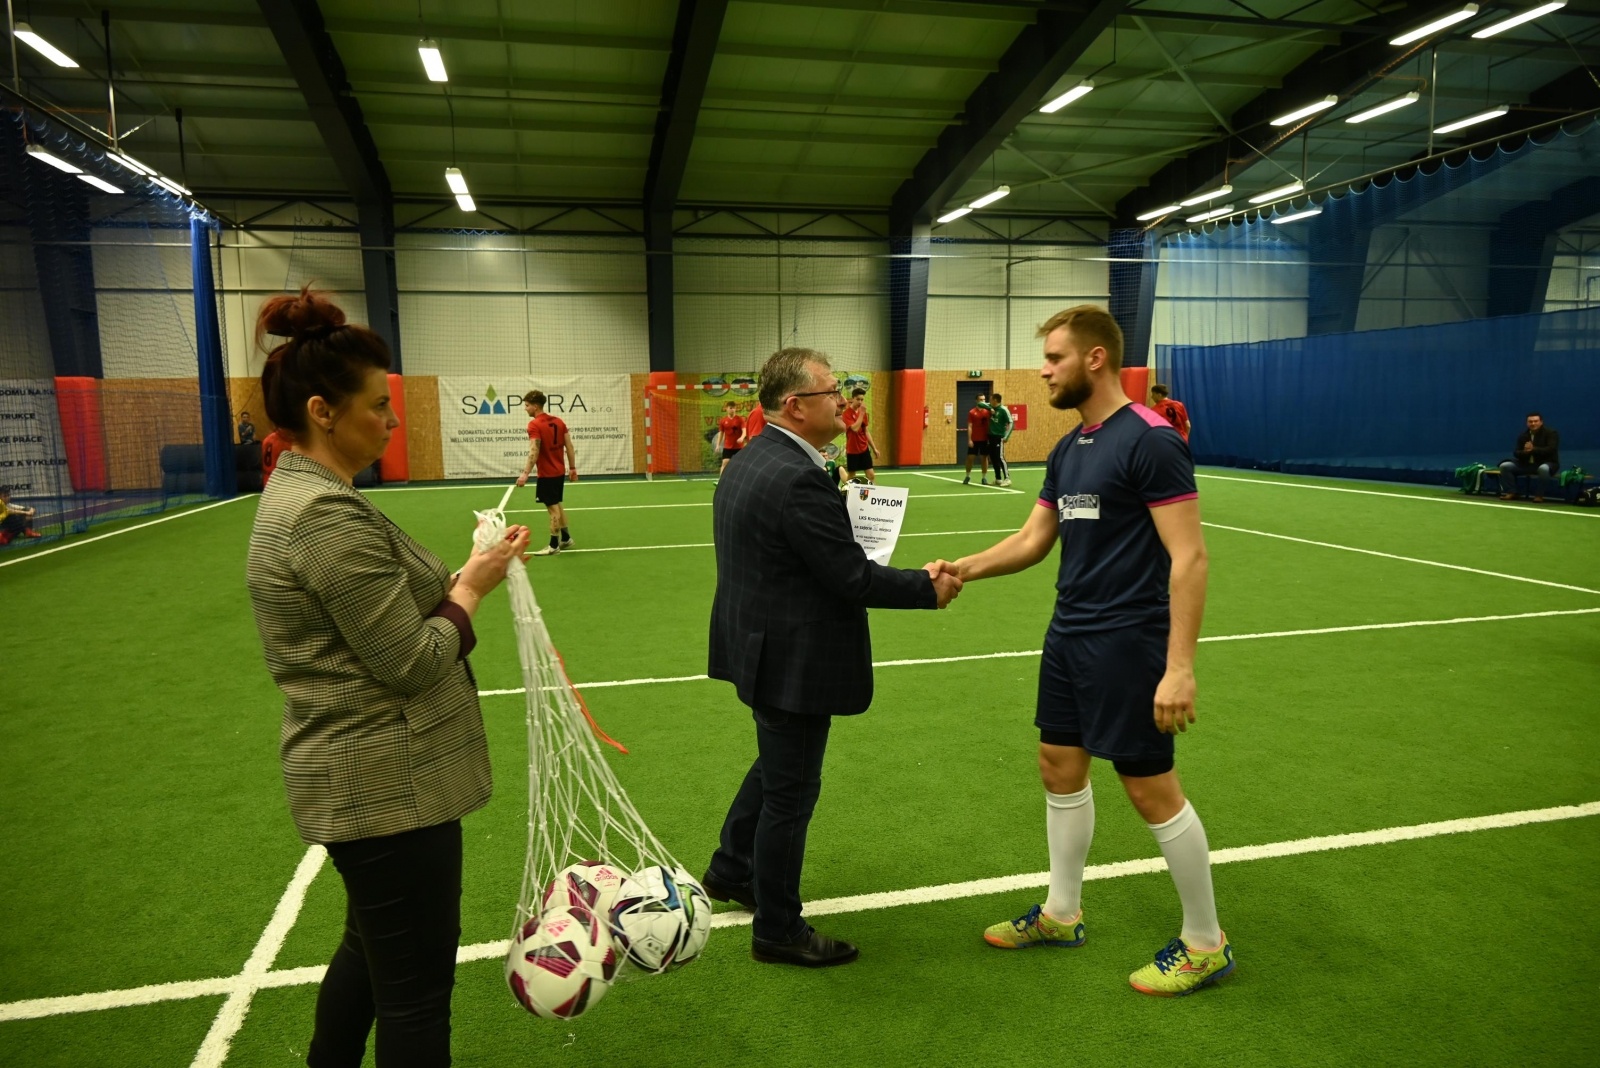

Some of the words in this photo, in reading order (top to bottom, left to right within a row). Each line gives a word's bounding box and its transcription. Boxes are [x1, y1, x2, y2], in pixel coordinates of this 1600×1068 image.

[1166, 407, 1177, 423] 9
[548, 422, 558, 445] 7
[871, 497, 903, 507] DYPLOM
[594, 873, 618, 882] adidas
